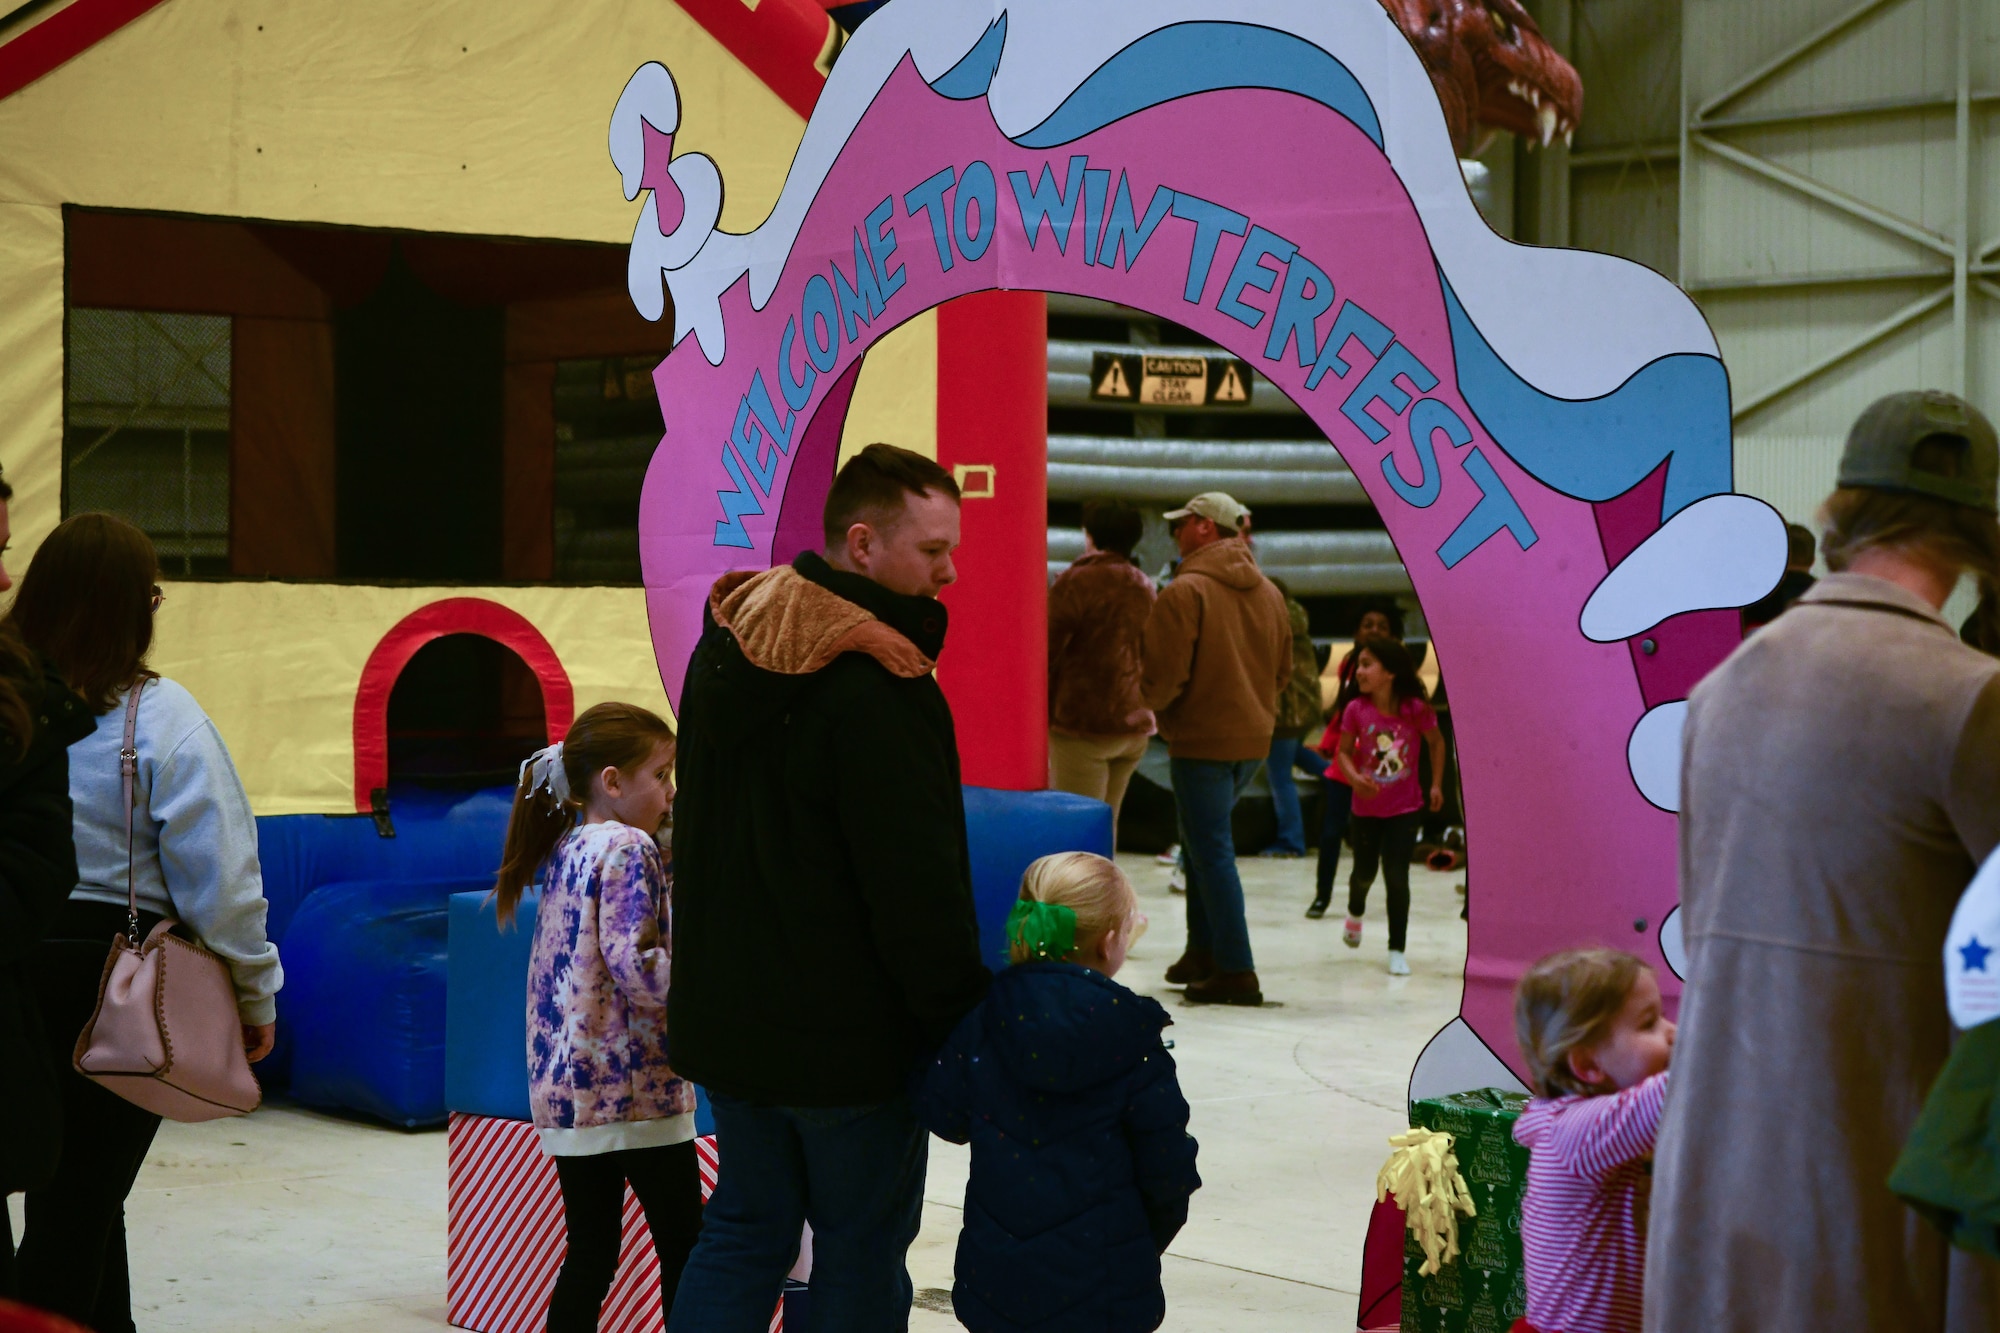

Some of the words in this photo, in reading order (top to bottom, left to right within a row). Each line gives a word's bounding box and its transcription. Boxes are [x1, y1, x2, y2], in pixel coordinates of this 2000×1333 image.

[713, 195, 907, 550] WELCOME
[903, 160, 997, 273] TO
[1007, 155, 1540, 570] WINTERFEST
[1147, 359, 1202, 375] CAUTION
[1161, 378, 1188, 390] STAY
